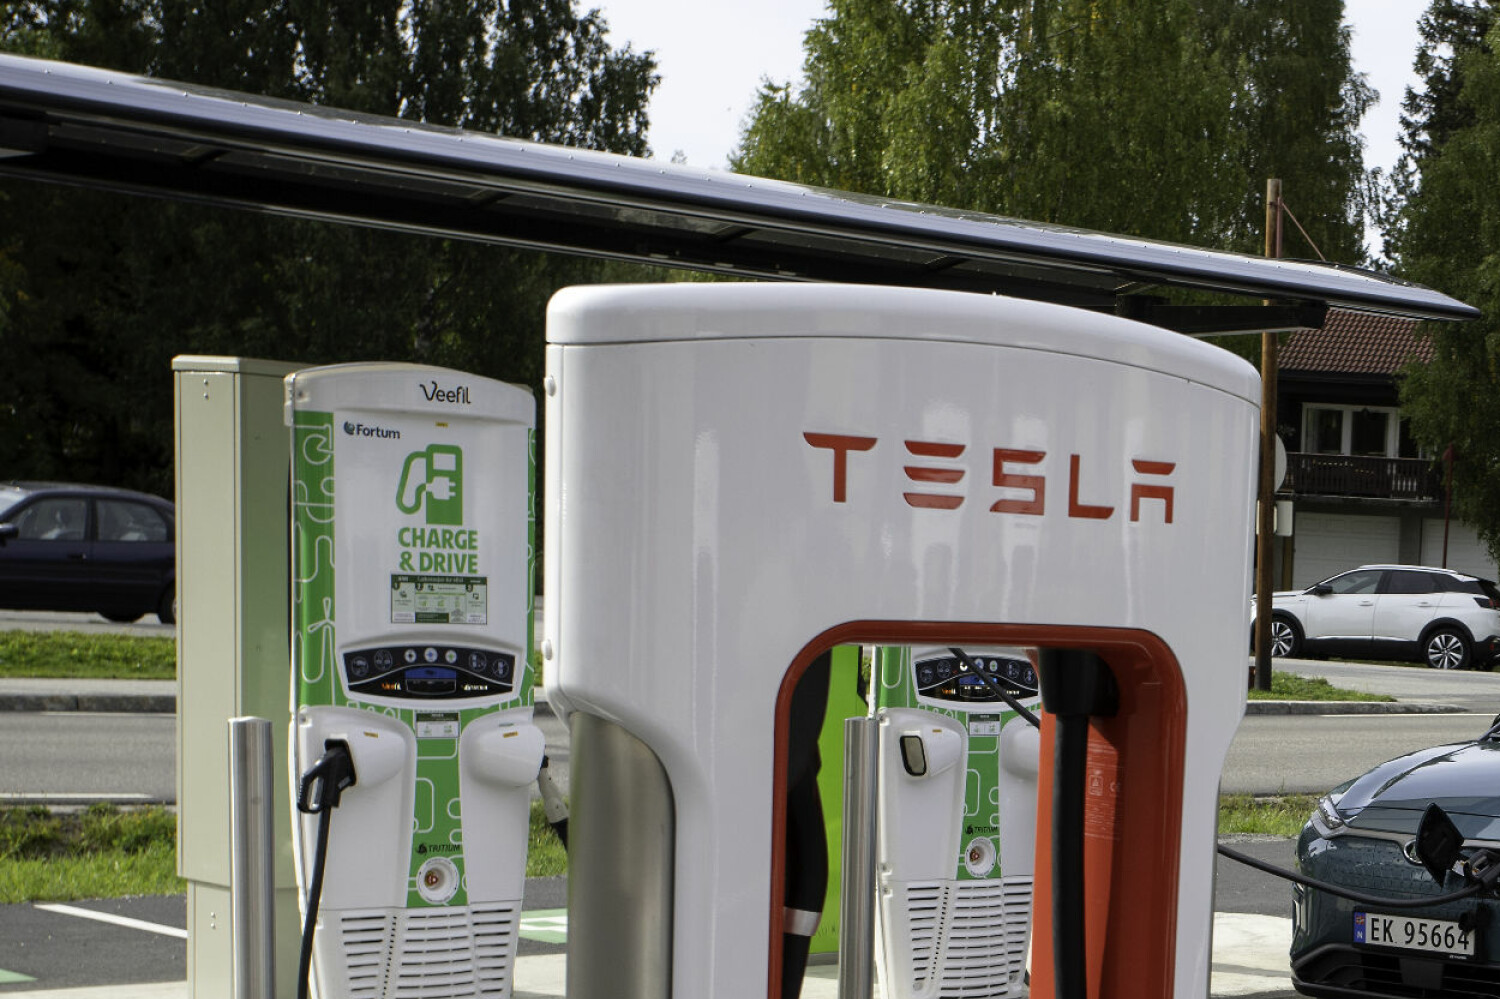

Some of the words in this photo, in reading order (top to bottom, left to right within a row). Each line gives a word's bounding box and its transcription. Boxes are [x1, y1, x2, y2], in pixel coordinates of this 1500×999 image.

[419, 380, 471, 404] Veefil
[356, 424, 401, 439] Fortum
[803, 432, 1176, 523] TESLA
[398, 527, 478, 550] CHARGE
[399, 551, 416, 572] &
[419, 552, 478, 574] DRIVE
[1371, 917, 1394, 943] EK
[1404, 921, 1469, 950] 95664
